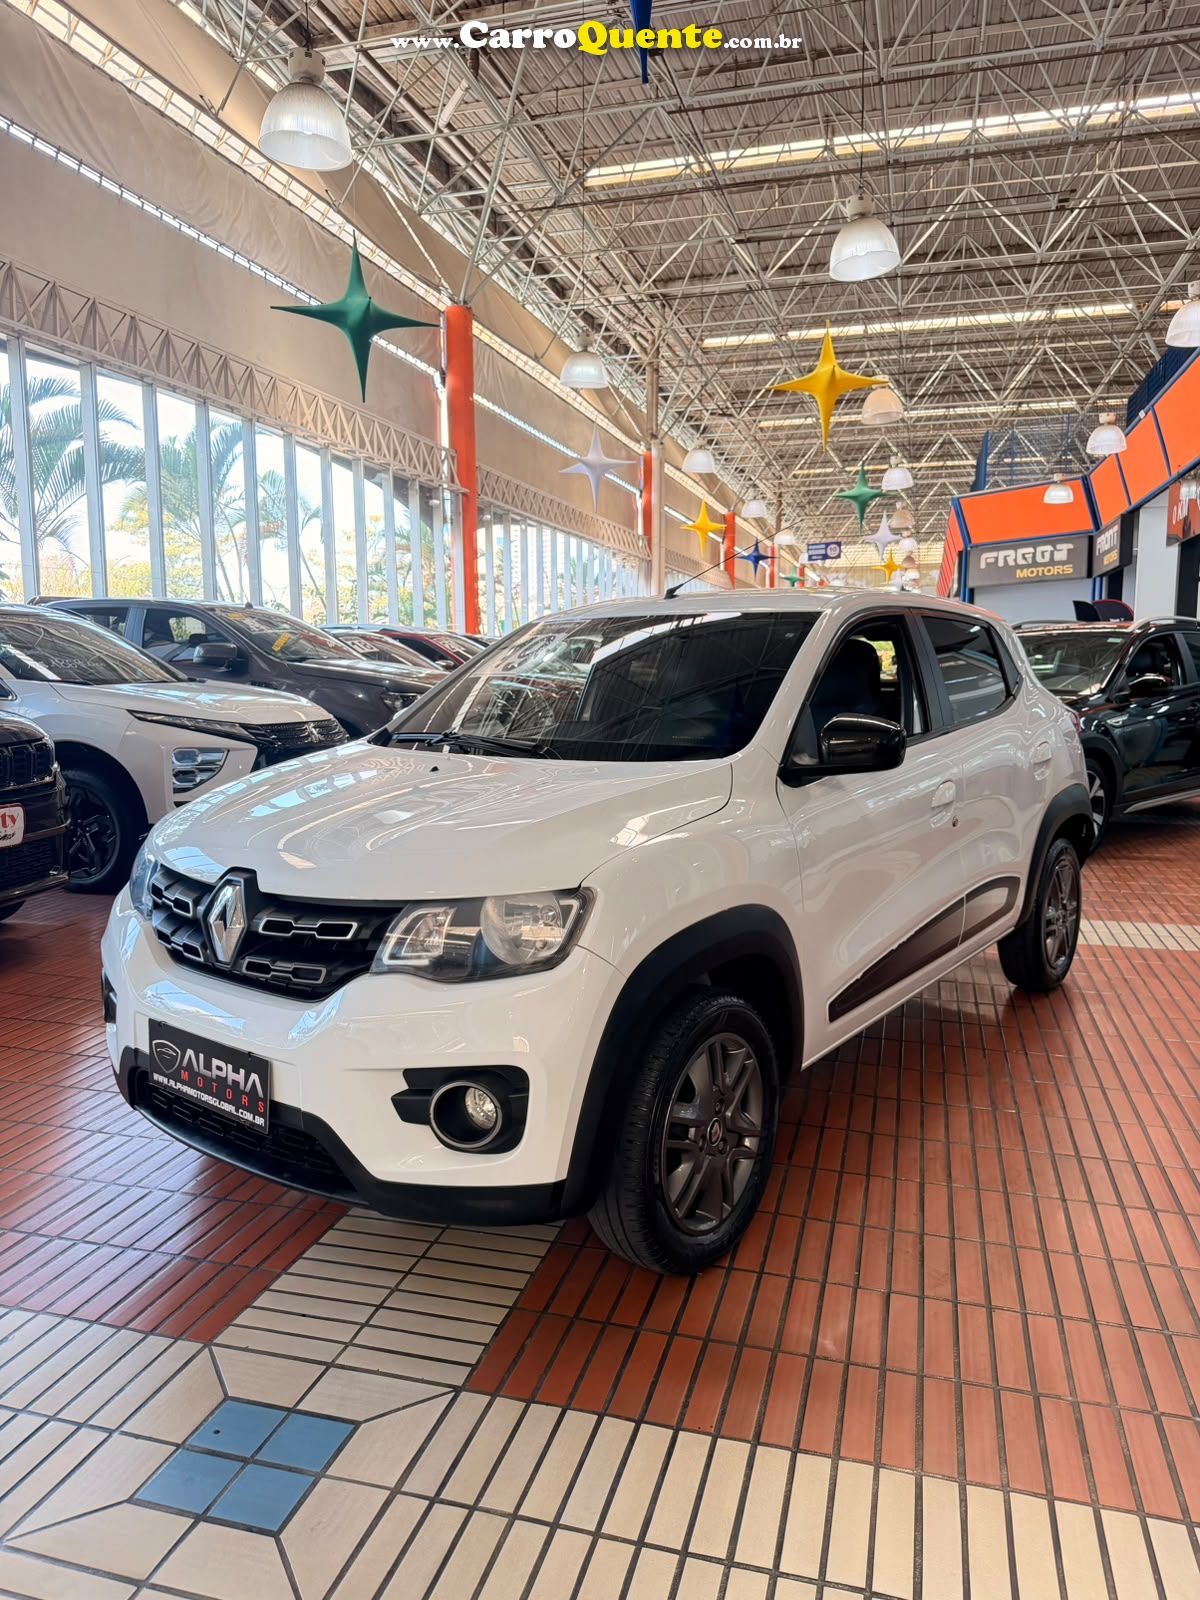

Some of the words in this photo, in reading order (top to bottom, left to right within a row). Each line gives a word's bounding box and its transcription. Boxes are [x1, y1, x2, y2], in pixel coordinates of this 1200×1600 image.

[1016, 564, 1073, 578] MOTORS
[180, 1070, 265, 1113] MOTORS
[182, 1048, 264, 1099] ALPHA
[152, 1072, 265, 1127] WWW.ALPHAMOTORSGLOBAL.COM.BR
